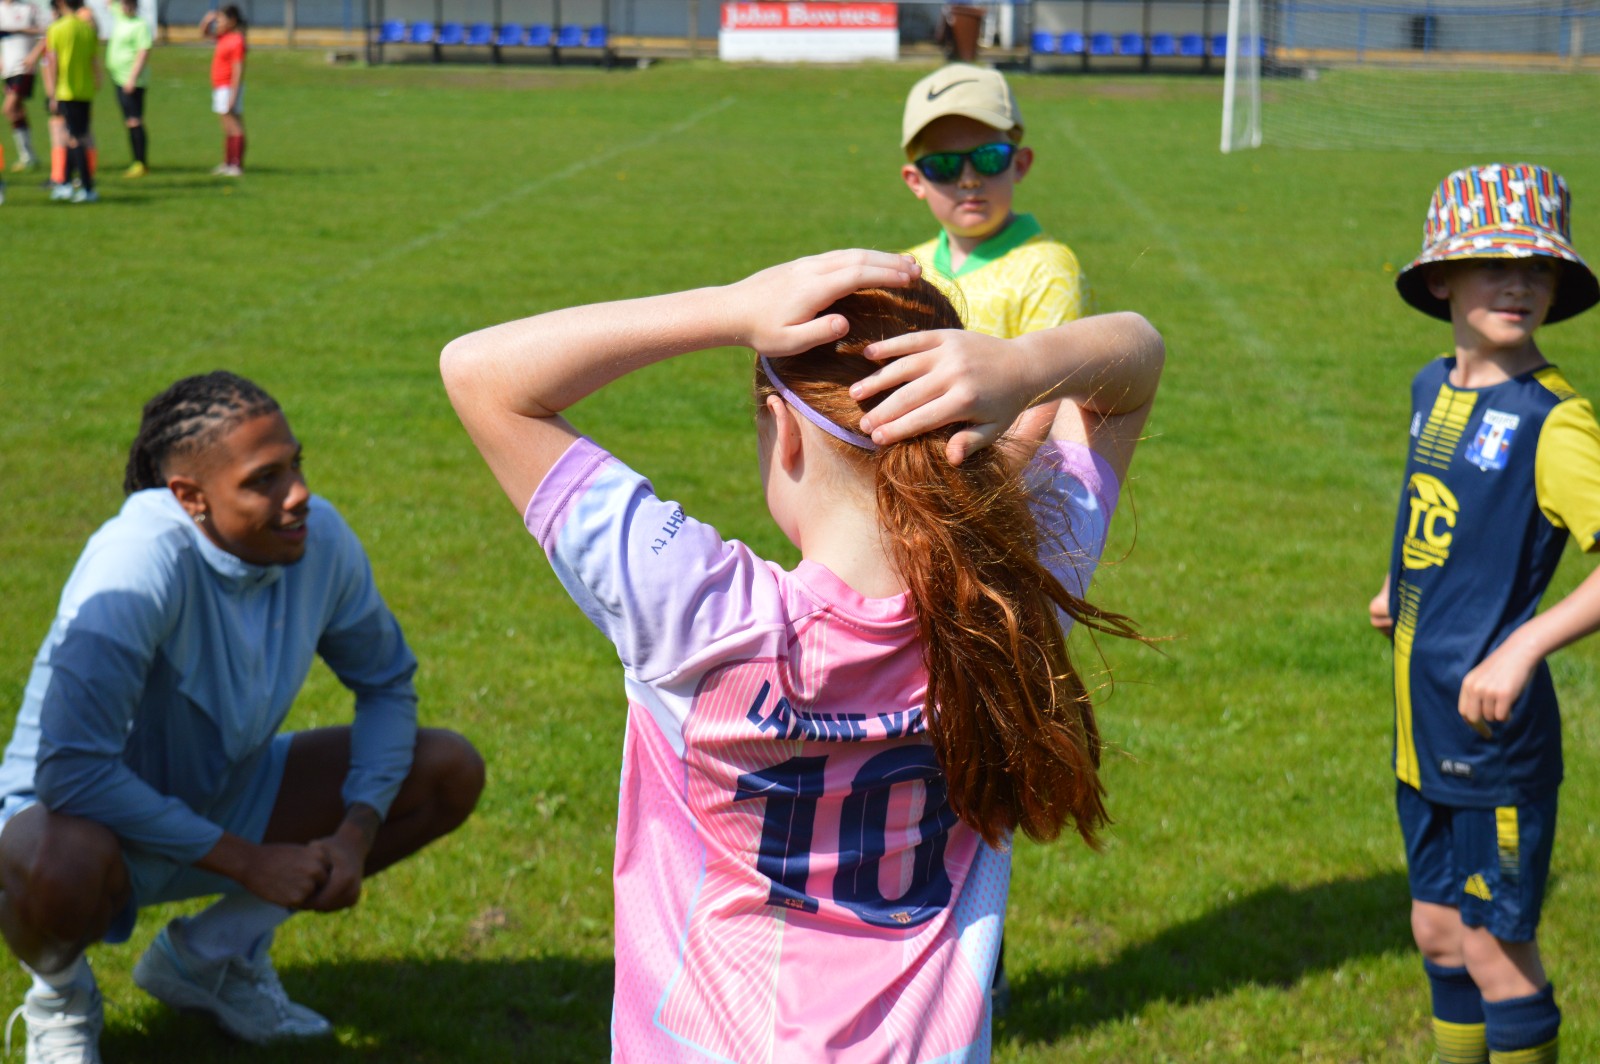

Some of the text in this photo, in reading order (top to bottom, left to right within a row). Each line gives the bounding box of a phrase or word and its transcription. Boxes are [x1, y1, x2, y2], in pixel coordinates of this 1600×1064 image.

[726, 2, 782, 31] John
[651, 505, 686, 555] GHT tv
[746, 679, 867, 742] LAMINE
[733, 744, 958, 929] 10
